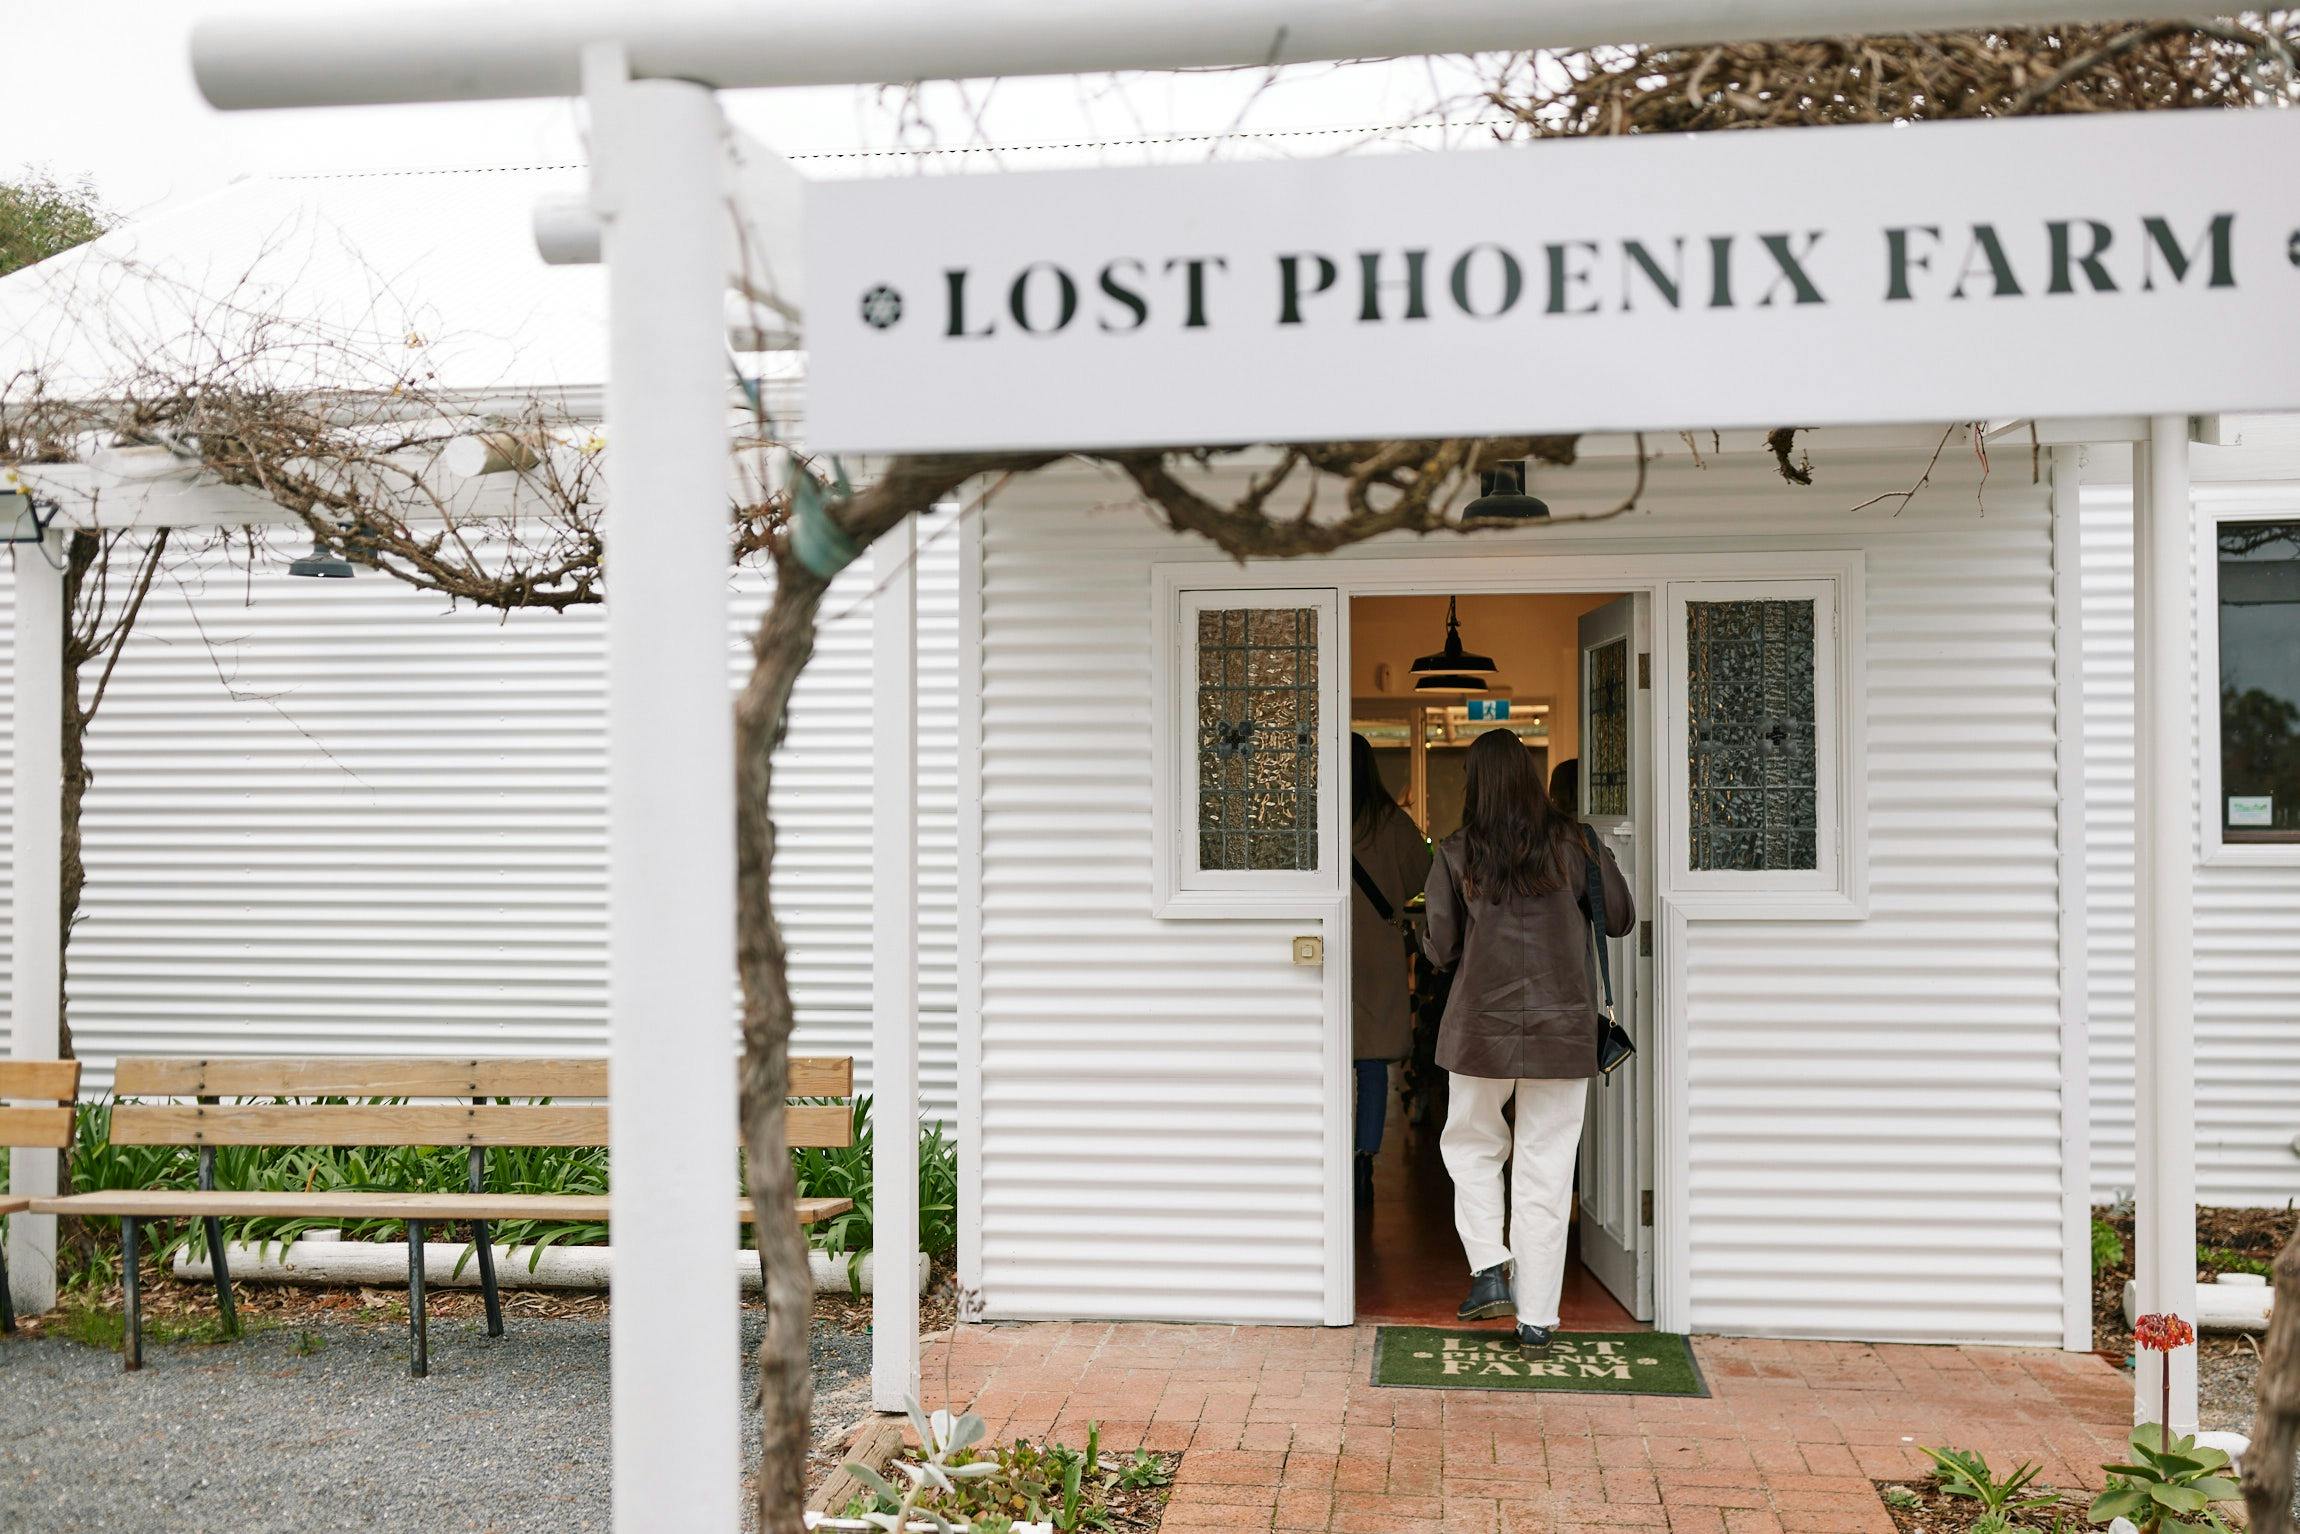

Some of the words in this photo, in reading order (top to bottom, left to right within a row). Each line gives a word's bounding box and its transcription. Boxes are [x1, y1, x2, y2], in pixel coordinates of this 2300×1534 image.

[943, 258, 1226, 338] LOST
[1276, 231, 1826, 325] PHOENIX
[1883, 212, 2237, 300] FARM
[1441, 1352, 1628, 1365] PHONIX
[1441, 1360, 1633, 1379] FARM
